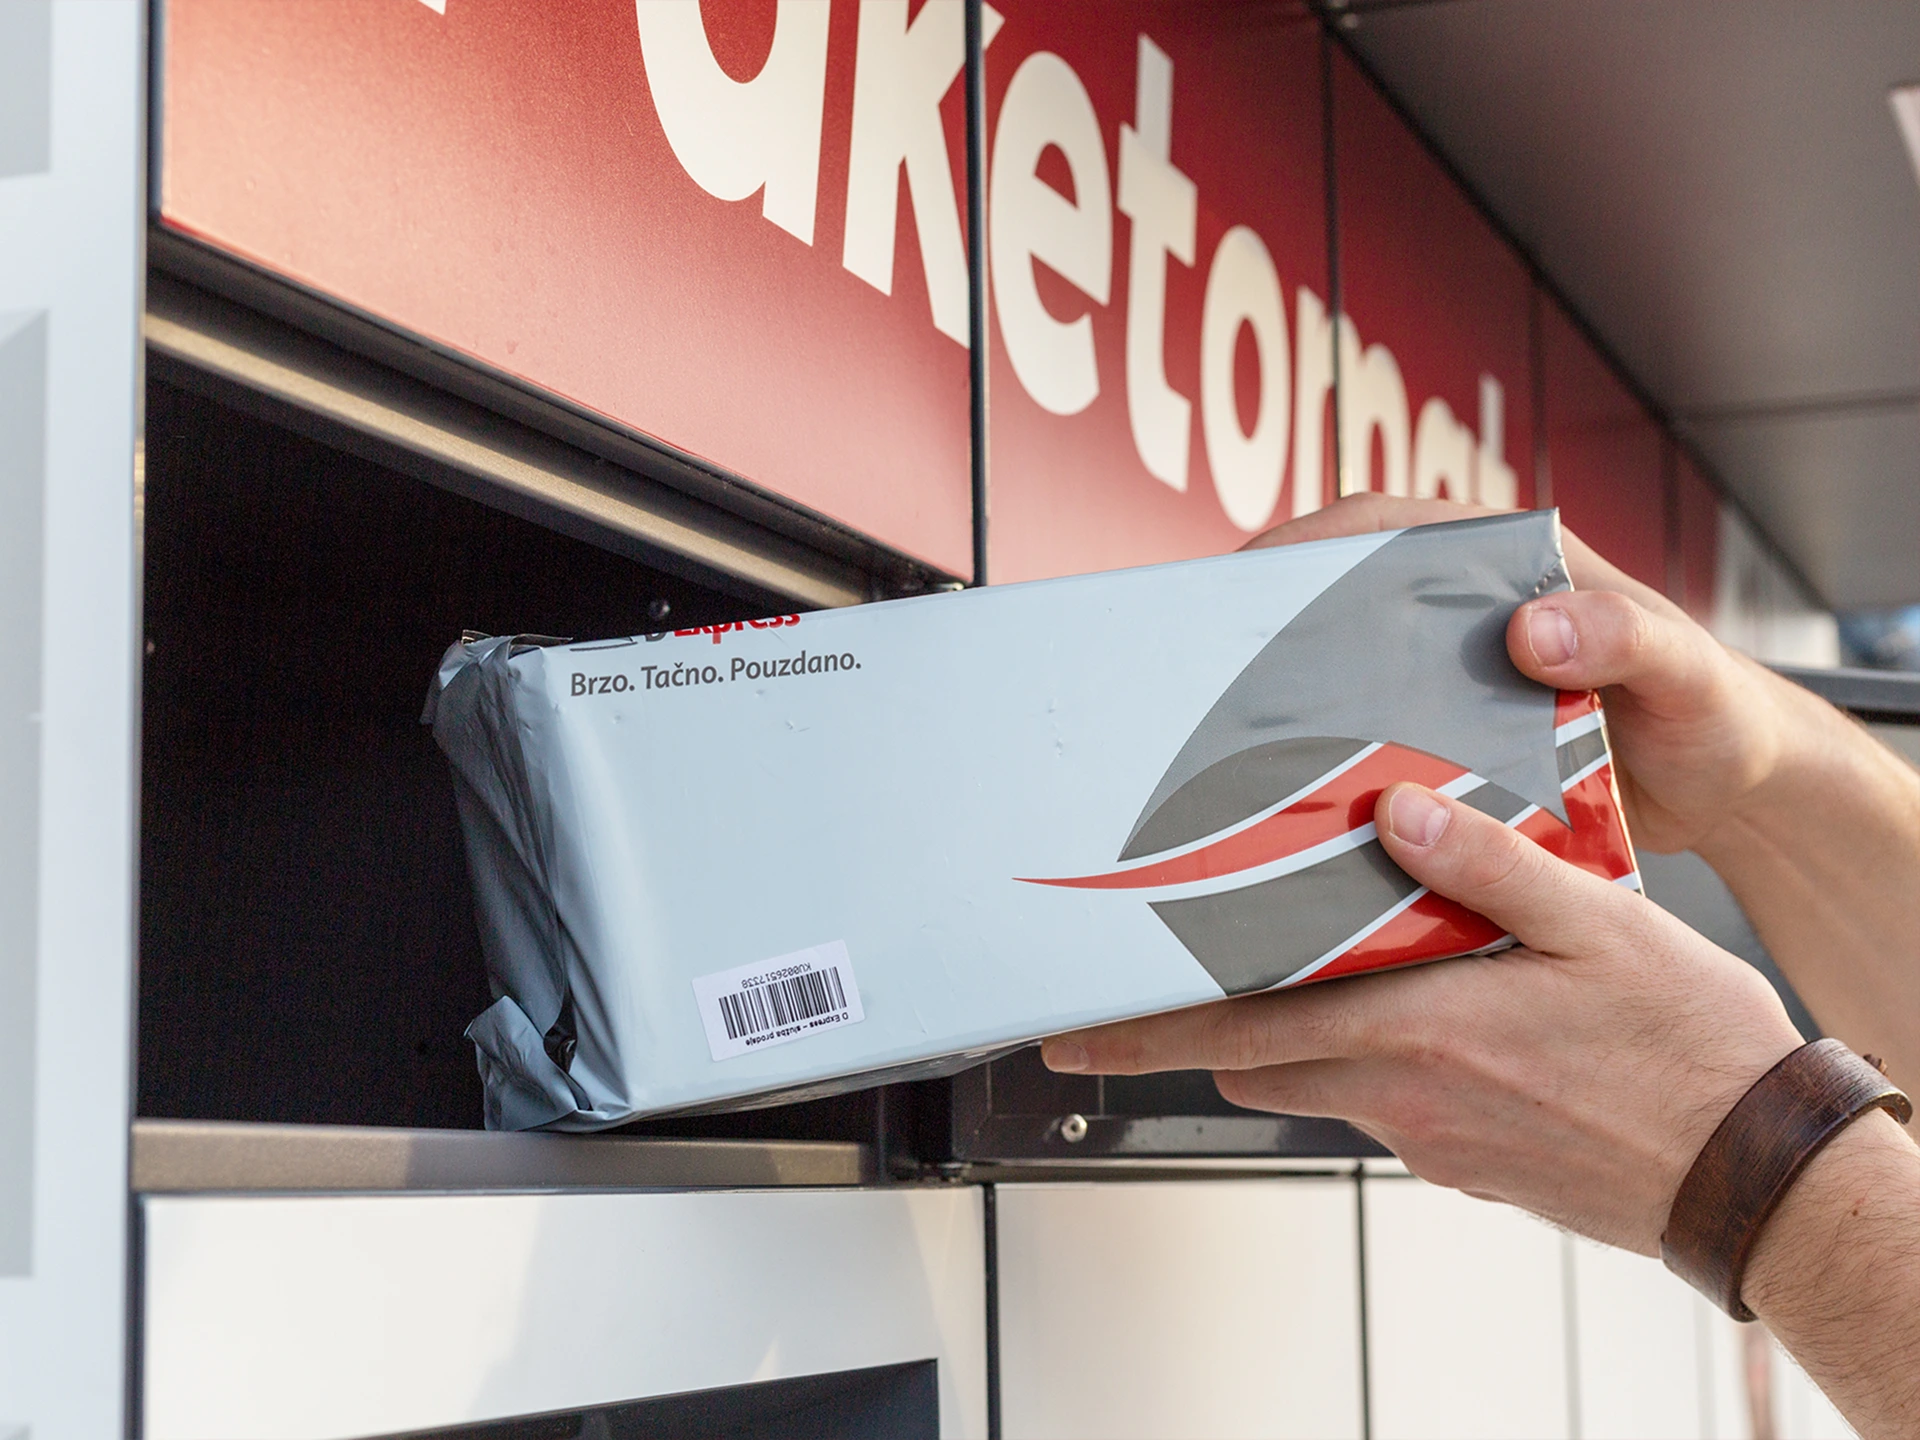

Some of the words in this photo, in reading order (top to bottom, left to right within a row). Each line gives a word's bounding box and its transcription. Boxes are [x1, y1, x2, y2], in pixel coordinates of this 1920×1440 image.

[417, 0, 1518, 531] ketomt
[570, 672, 635, 697] Brzo.
[640, 661, 724, 690] Tačno.
[730, 649, 862, 682] Pouzdano.
[808, 1013, 841, 1029] Express
